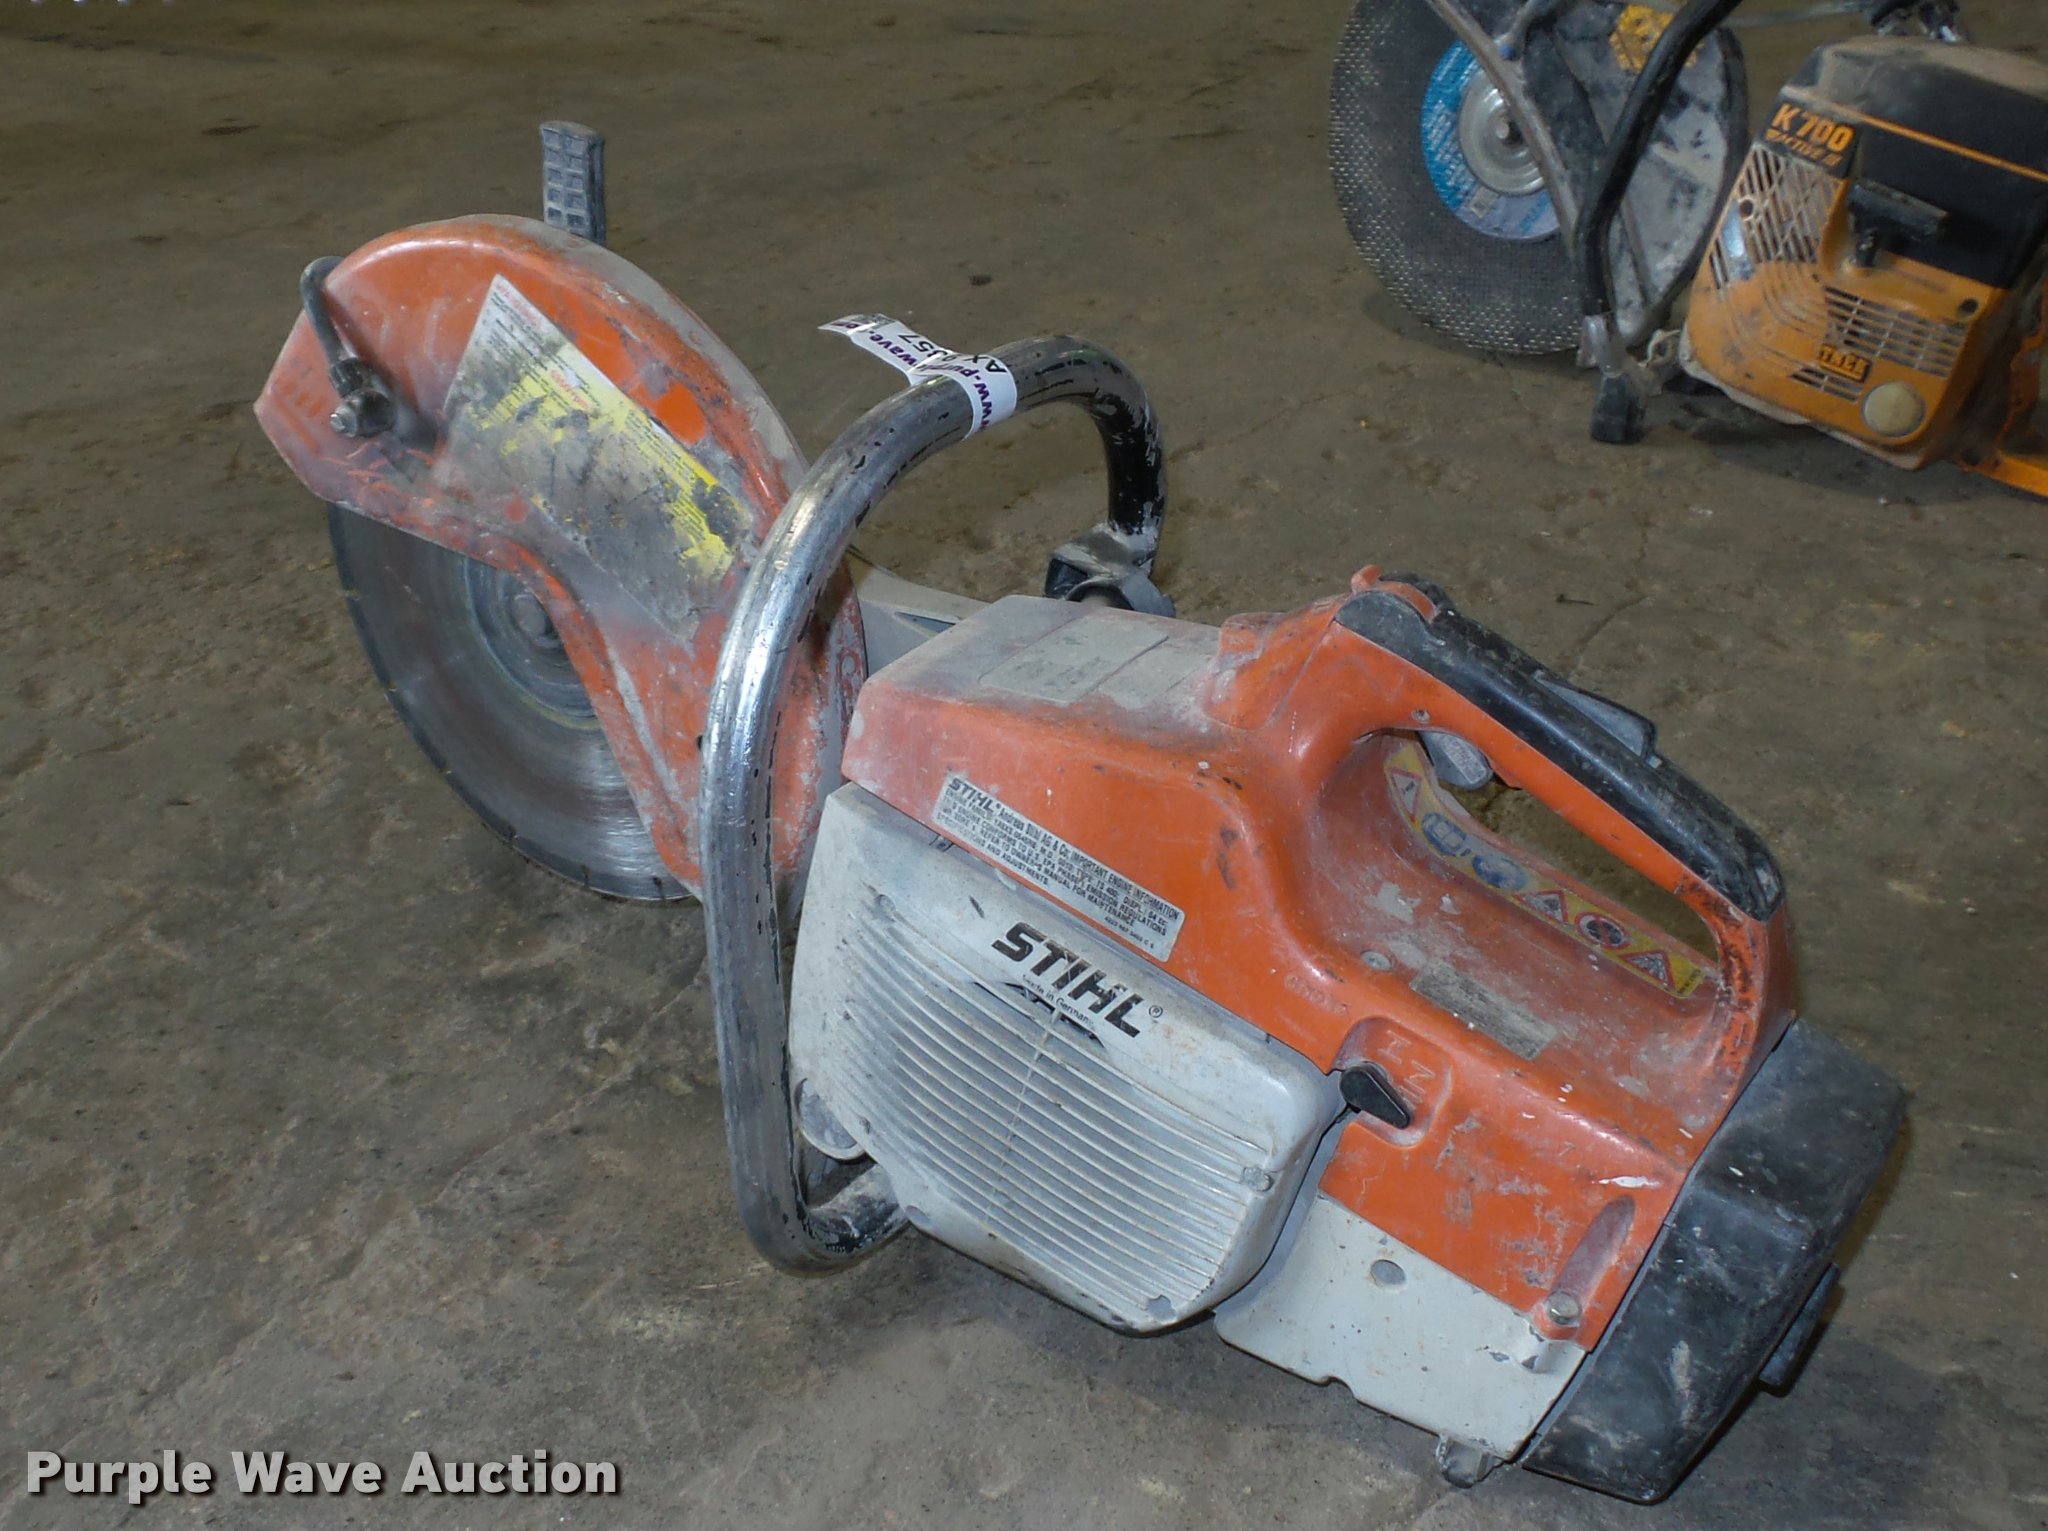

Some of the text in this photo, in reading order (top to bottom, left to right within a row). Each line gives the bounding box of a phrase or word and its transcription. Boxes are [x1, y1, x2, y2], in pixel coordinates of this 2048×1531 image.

[1770, 102, 1857, 153] K 700
[948, 776, 996, 813] STIHL
[998, 806, 1026, 831] Andreas
[1040, 832, 1052, 847] AG
[1051, 839, 1059, 851] &
[1070, 850, 1107, 879] IMPORTANT
[1107, 872, 1133, 894] ENGINE
[1131, 886, 1179, 921] INFORMATION
[957, 805, 980, 824] ENGINE
[980, 820, 1017, 847] CONFORMS
[1017, 842, 1027, 853] TO
[1042, 857, 1056, 870] EPA
[1085, 883, 1118, 908] EMISSION
[1119, 903, 1167, 936] REGULATIONS
[978, 827, 1000, 846] REFER
[1001, 841, 1010, 852] TO
[1042, 866, 1071, 889] MANUAL
[1072, 884, 1087, 898] FOR
[1086, 893, 1135, 927] MAINTENANCE
[986, 842, 1001, 856] AND
[1000, 851, 1049, 885] ADJUSTMENTS
[1096, 879, 1105, 890] TS
[991, 921, 1144, 1038] STIHL
